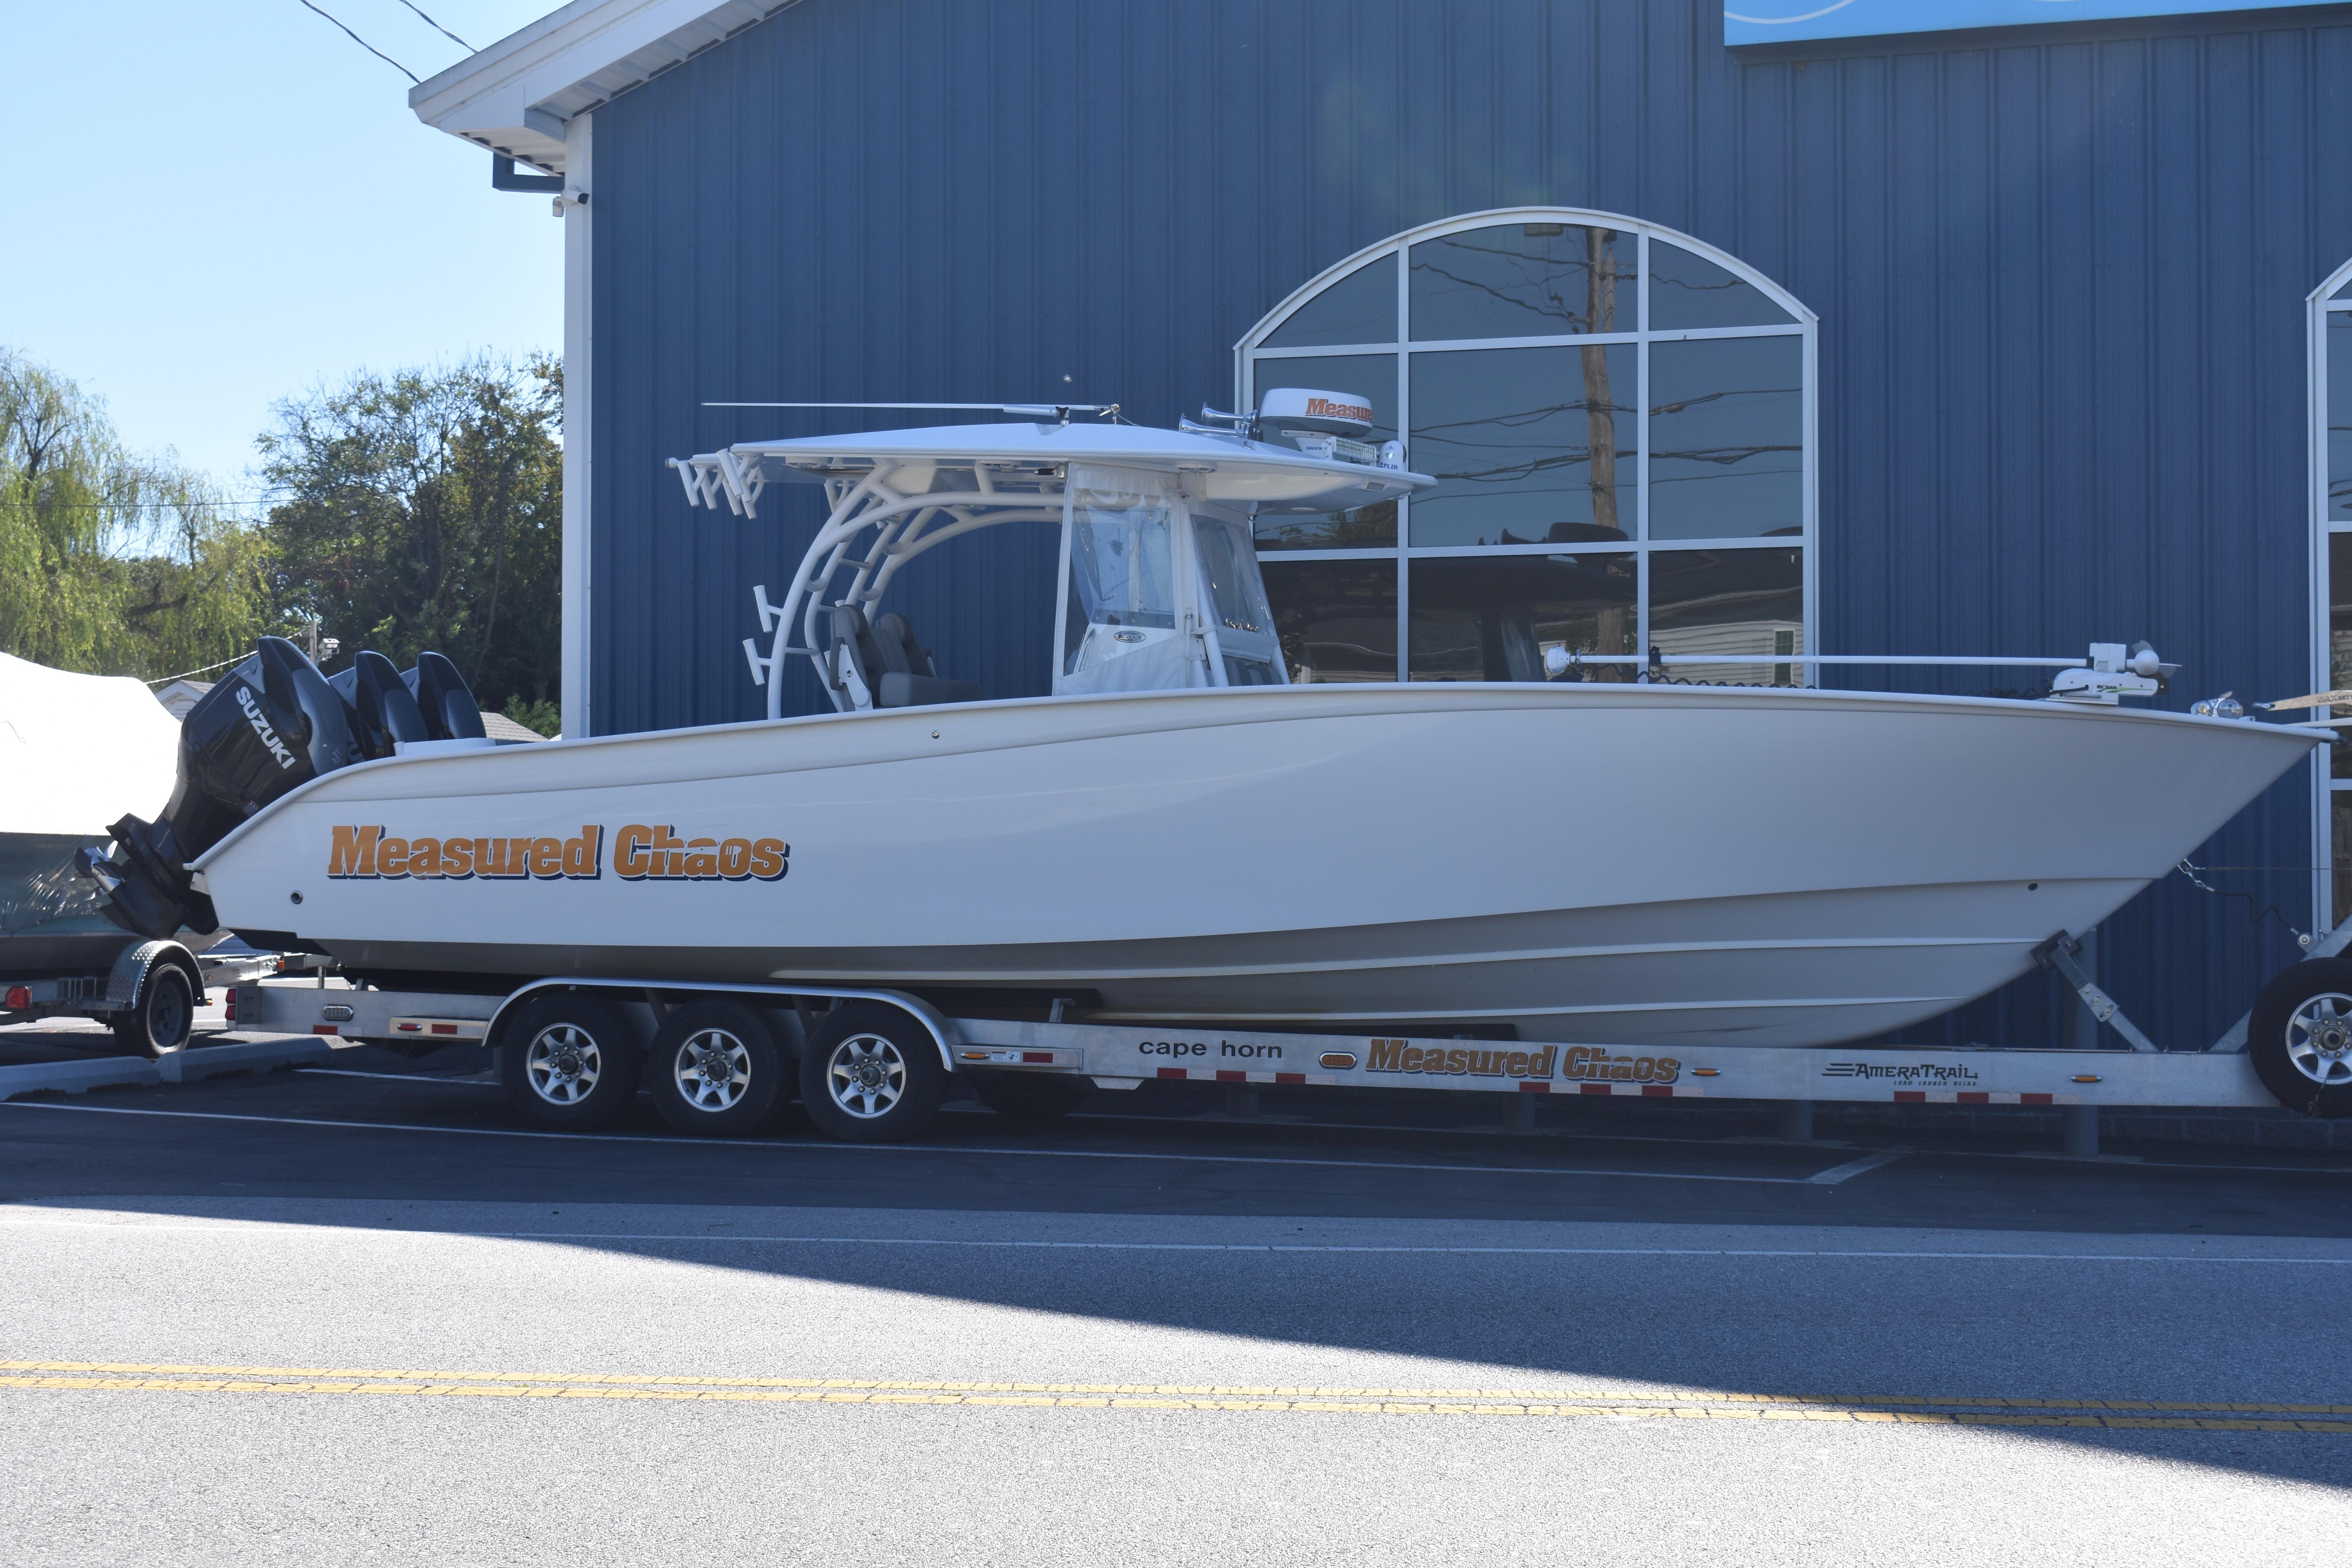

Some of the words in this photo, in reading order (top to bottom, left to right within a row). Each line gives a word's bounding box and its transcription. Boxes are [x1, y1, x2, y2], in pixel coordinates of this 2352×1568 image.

[236, 686, 296, 769] SUZUKI
[327, 825, 603, 880] Measured
[614, 824, 790, 881] Chaos
[1139, 1042, 1207, 1058] cape
[1221, 1040, 1282, 1058] horn
[1366, 1039, 1558, 1079] Measured
[1563, 1046, 1682, 1084] Chaos
